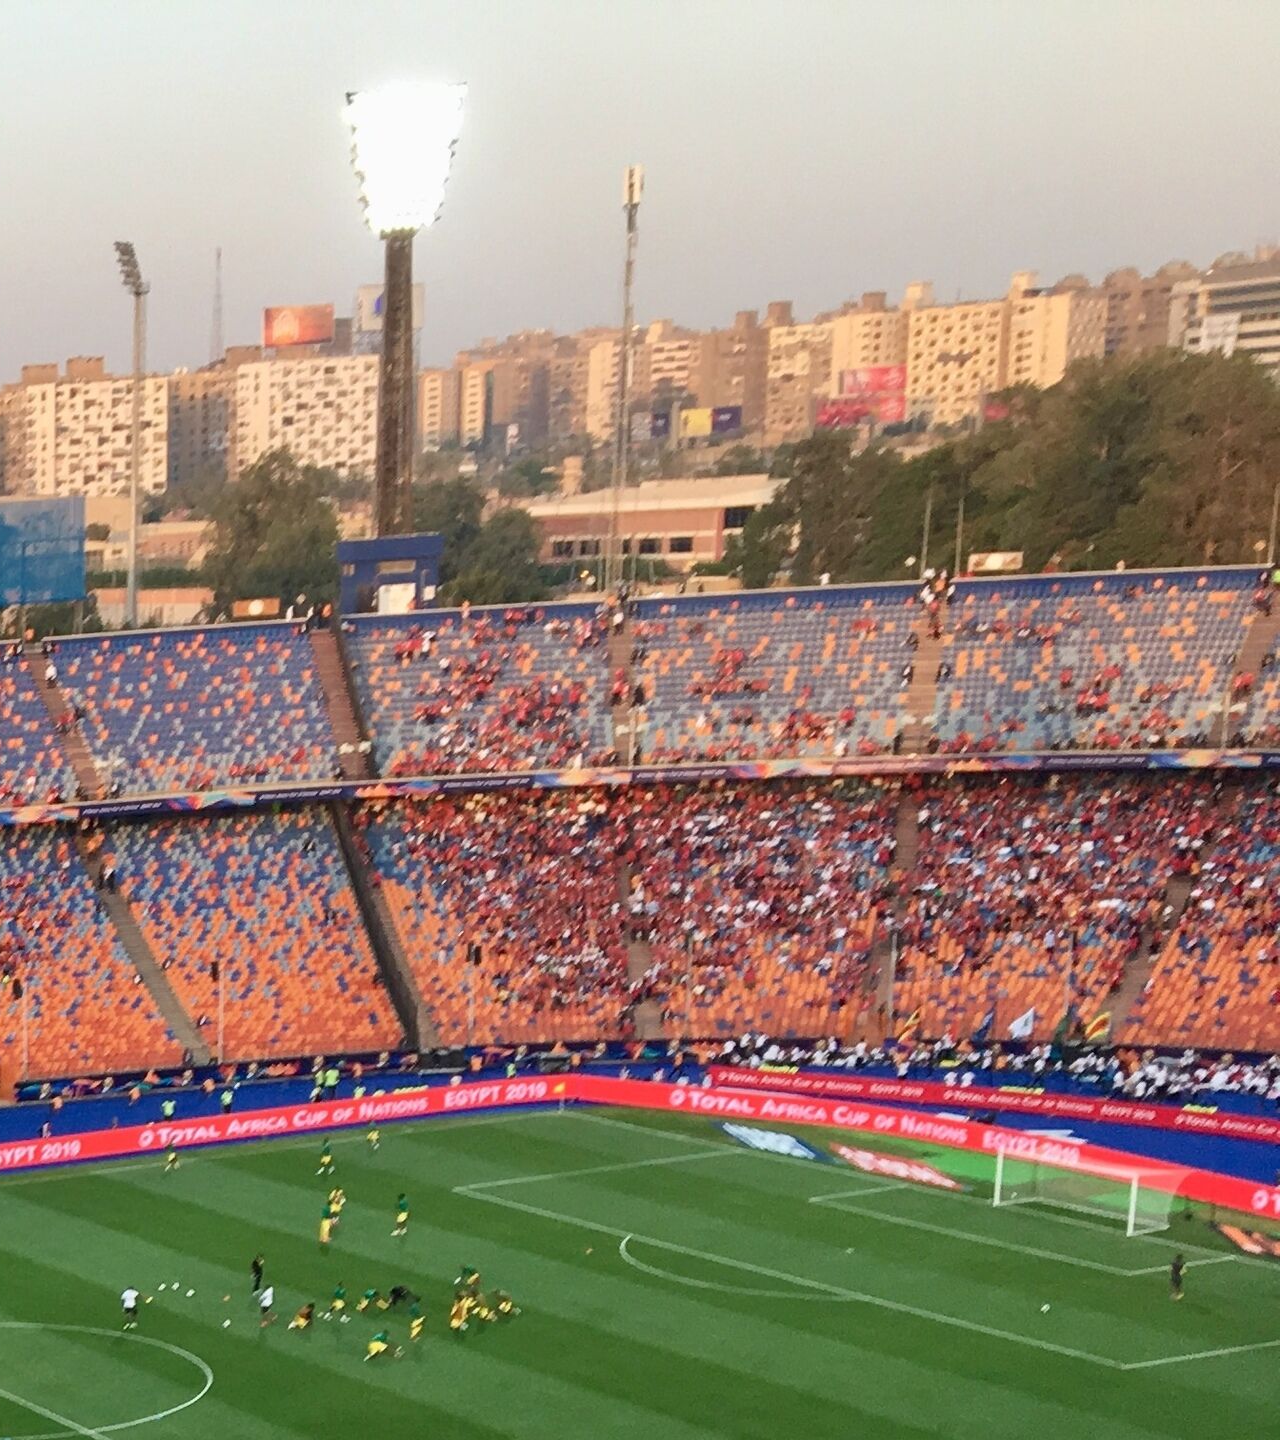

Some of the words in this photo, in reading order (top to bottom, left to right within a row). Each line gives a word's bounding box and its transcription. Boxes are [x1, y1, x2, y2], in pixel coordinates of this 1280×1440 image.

[157, 1125, 220, 1145] TOTAL
[226, 1115, 288, 1136] AFRICA
[292, 1109, 329, 1126] CUP
[332, 1106, 354, 1122] OF
[359, 1096, 428, 1118] NATIONS
[444, 1084, 502, 1108] EGYPT
[505, 1080, 547, 1100] 2019
[687, 1090, 755, 1114] TOTAL
[760, 1098, 827, 1121] AFRICA
[832, 1105, 870, 1126] CUP
[874, 1114, 896, 1130] OF
[900, 1114, 968, 1144] NATIONS
[41, 1139, 82, 1160] 2019
